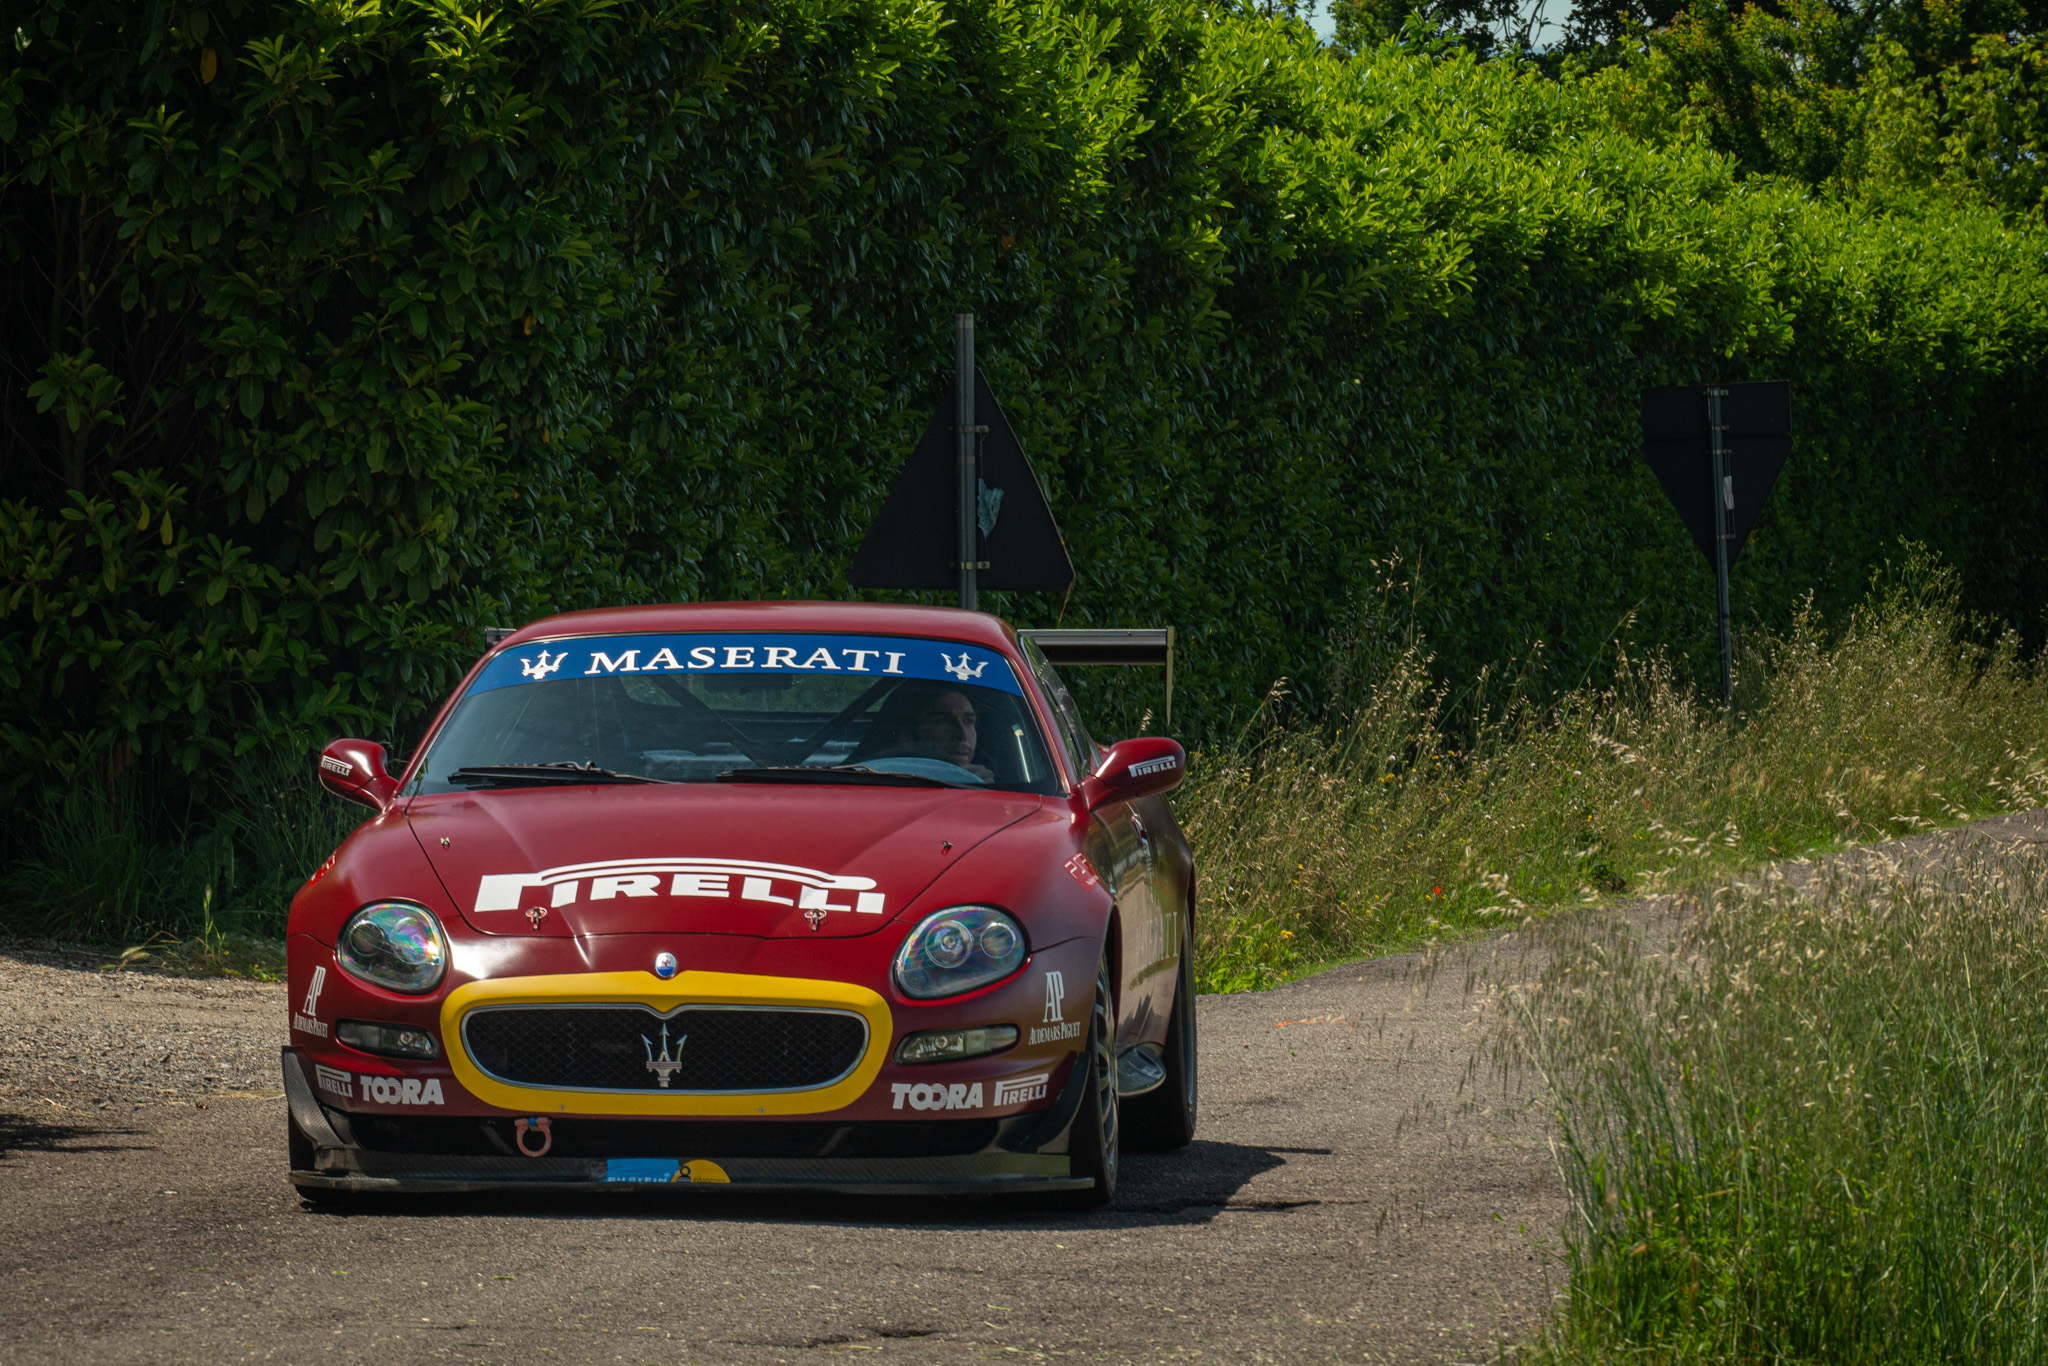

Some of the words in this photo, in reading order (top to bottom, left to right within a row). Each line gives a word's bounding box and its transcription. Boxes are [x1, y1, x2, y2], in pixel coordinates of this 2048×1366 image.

[584, 646, 906, 674] MASERATI
[321, 755, 353, 776] PIRELLI
[1128, 755, 1176, 777] PIRELLI
[474, 857, 886, 914] PIRELLI
[303, 965, 326, 1016] AP
[1043, 970, 1065, 1022] AP
[1028, 1025, 1060, 1046] AUDEMARS
[1060, 1022, 1081, 1040] PIGUET
[315, 1064, 353, 1097] PIRELLI
[360, 1075, 445, 1105] TOORA
[891, 1082, 983, 1110] TOORA
[994, 1073, 1049, 1106] PIRELLI
